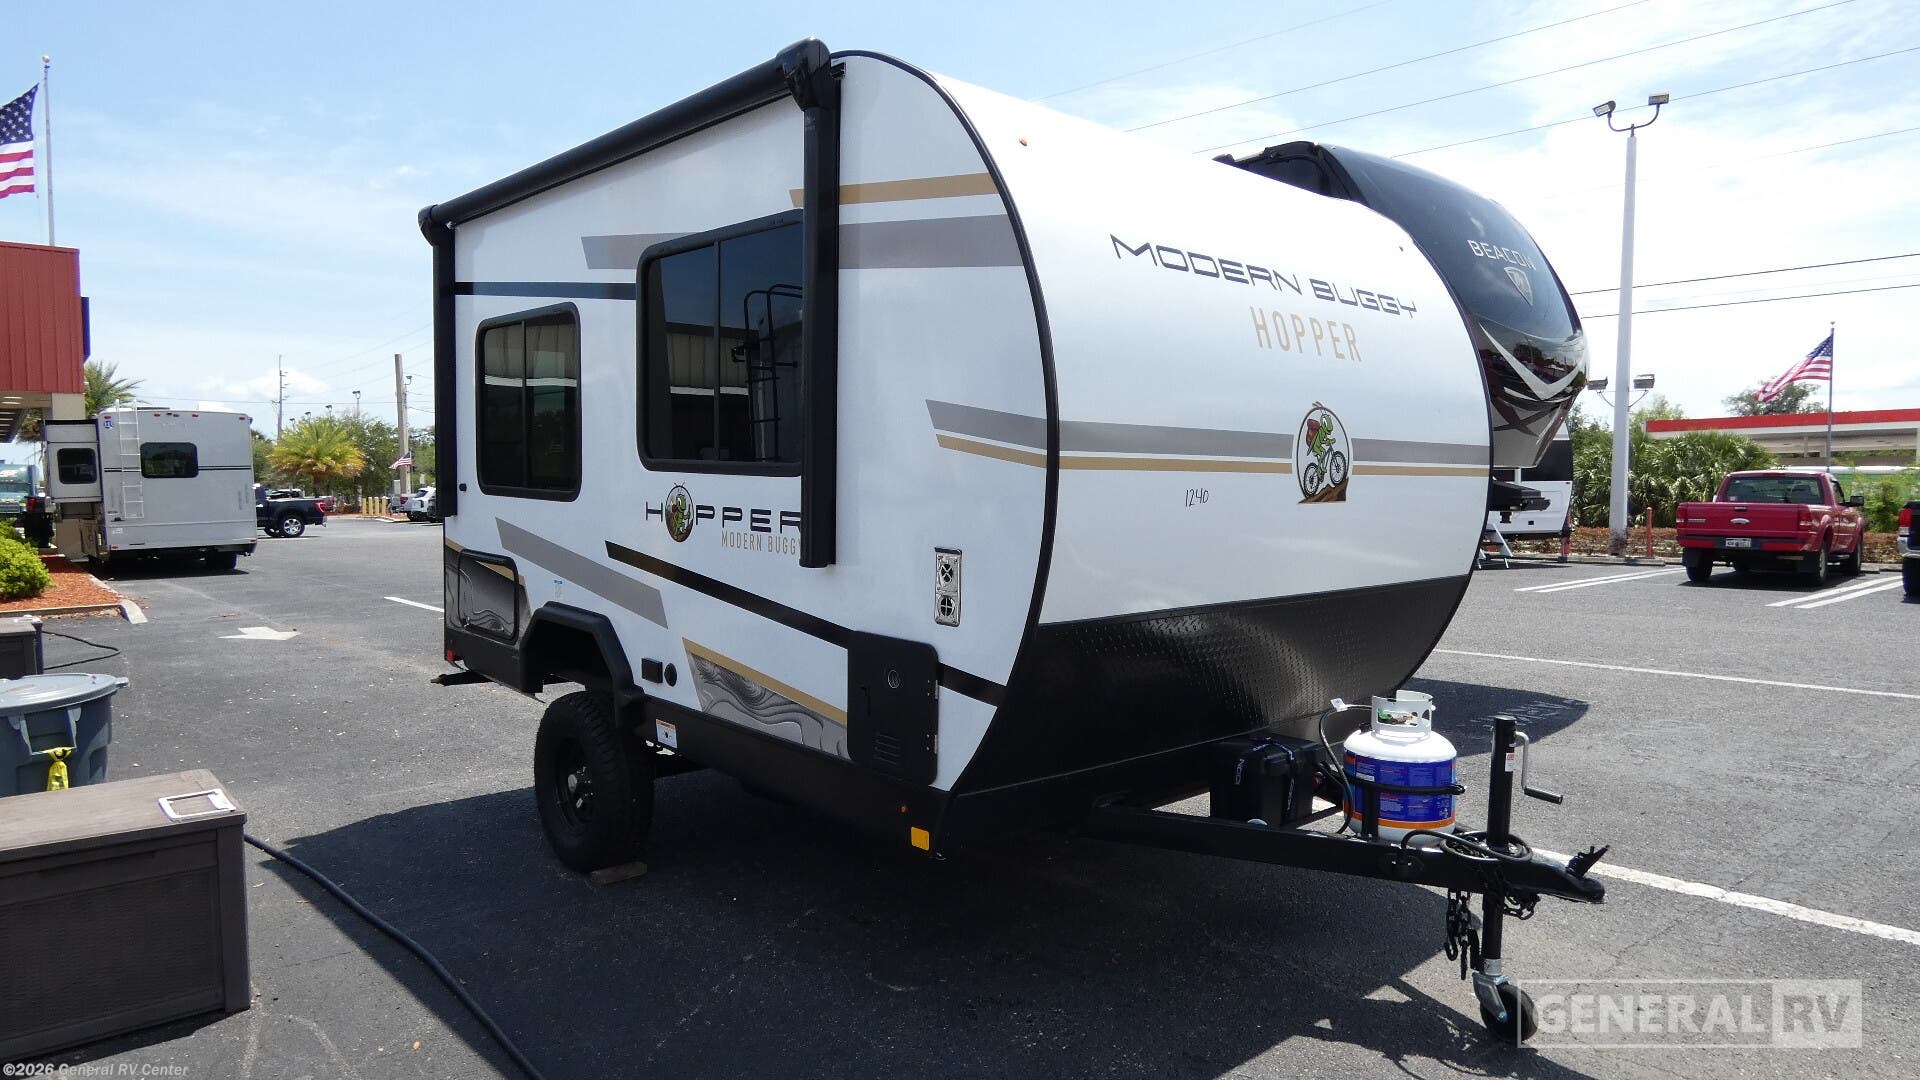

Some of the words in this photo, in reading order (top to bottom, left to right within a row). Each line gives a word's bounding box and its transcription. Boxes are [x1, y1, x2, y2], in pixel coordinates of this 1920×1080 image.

[1467, 239, 1537, 271] BEACON
[1110, 234, 1302, 295] MODERN
[1309, 278, 1418, 319] BUGGY
[1249, 305, 1362, 363] HOPPER
[1185, 488, 1209, 507] 1240
[721, 530, 762, 552] MODERN
